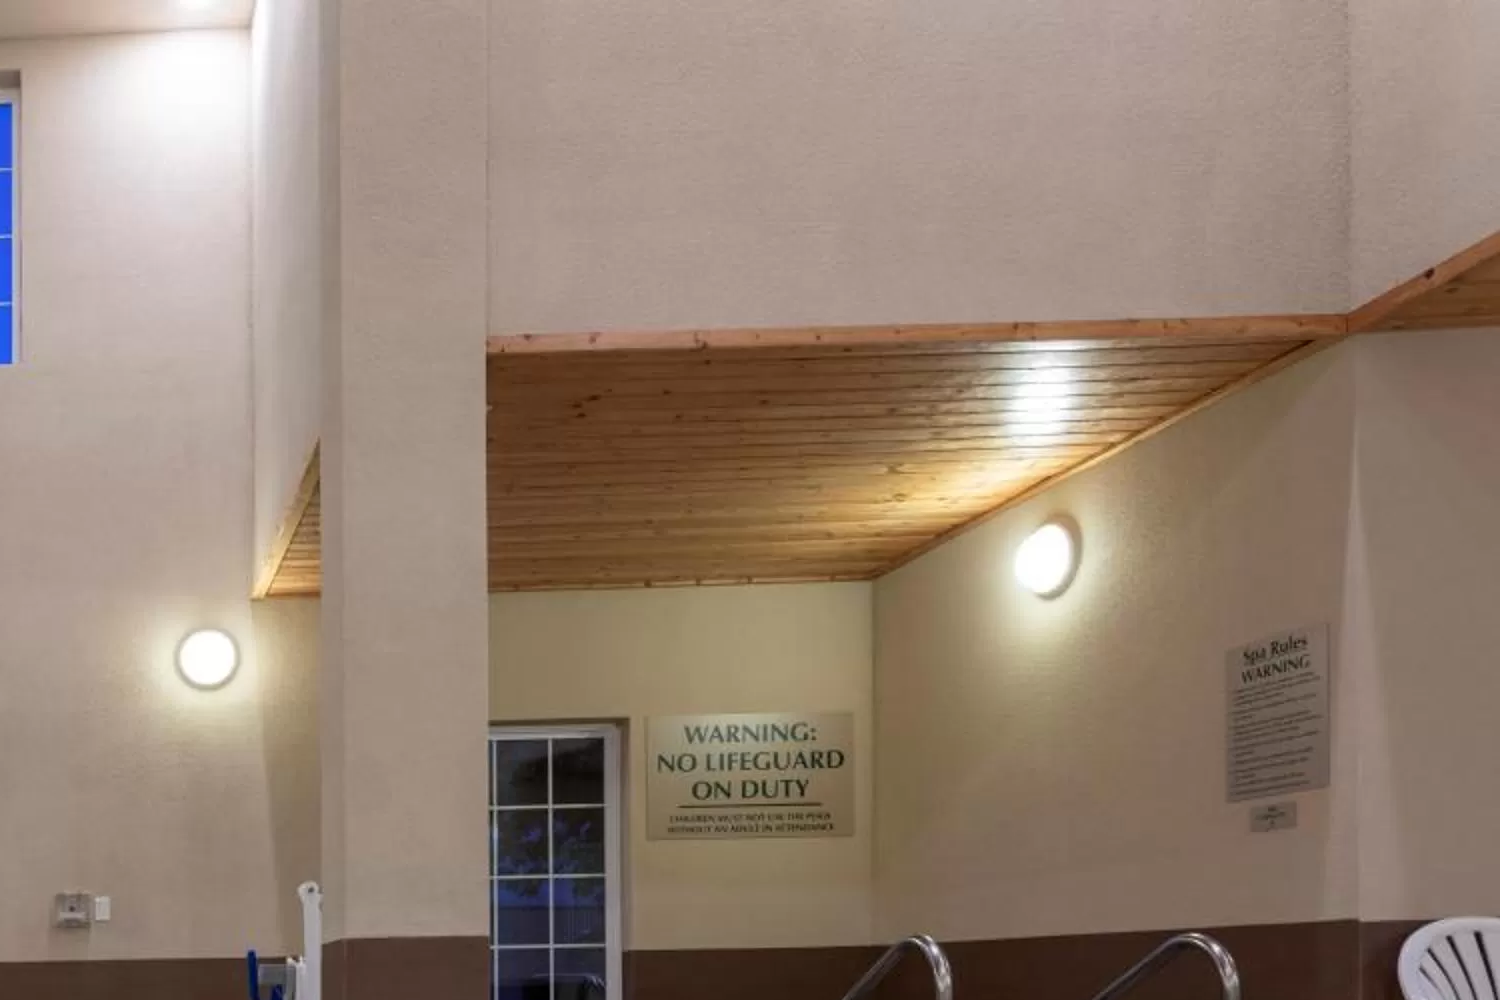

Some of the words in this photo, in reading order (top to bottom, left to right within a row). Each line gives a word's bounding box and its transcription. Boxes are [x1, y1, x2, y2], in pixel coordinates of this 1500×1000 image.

[1241, 654, 1311, 683] WARNING
[684, 722, 817, 744] WARNING:
[657, 753, 697, 773] NO
[705, 749, 845, 772] LIFEGUARD
[692, 780, 732, 800] ON
[741, 779, 809, 799] DUTY
